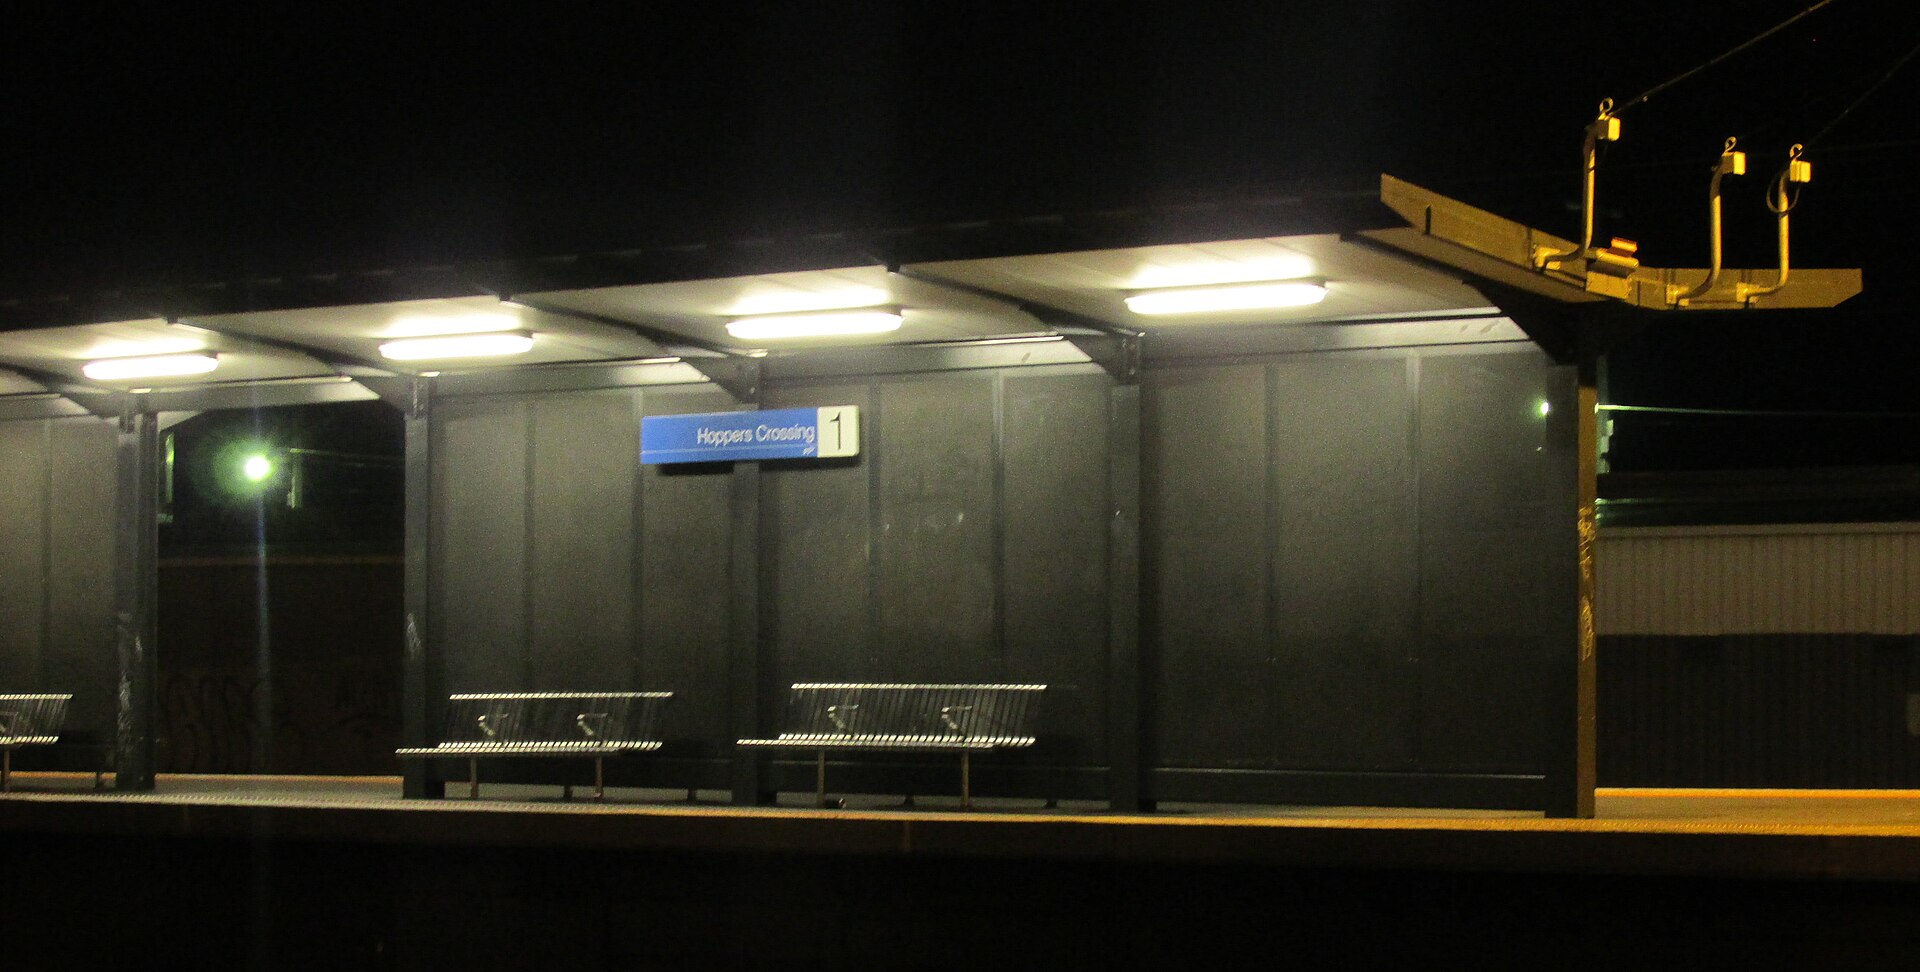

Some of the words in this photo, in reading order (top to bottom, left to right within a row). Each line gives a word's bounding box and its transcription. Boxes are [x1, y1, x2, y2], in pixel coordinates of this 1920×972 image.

[697, 427, 752, 446] Hoppers
[756, 423, 815, 443] Crossing
[830, 411, 841, 450] 1
